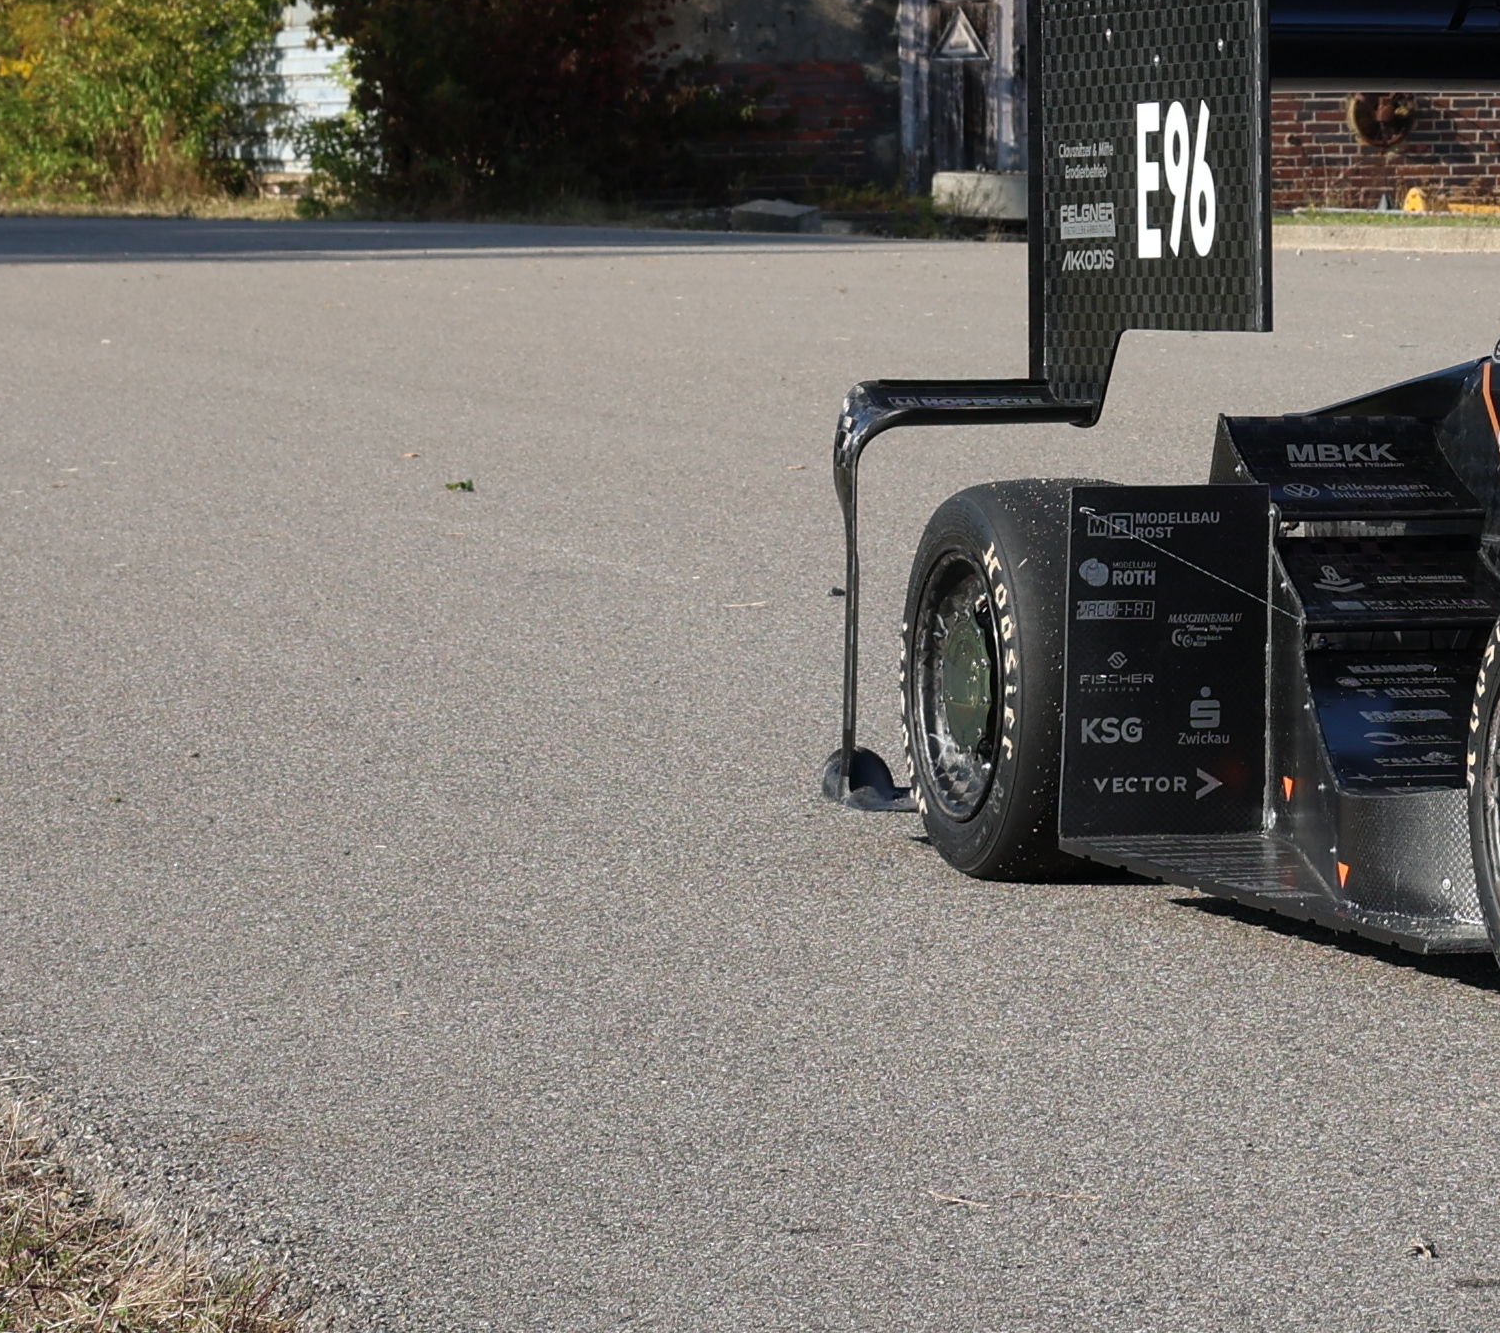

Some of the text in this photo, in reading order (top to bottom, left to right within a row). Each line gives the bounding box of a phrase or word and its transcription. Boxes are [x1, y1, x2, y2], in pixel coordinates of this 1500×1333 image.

[1137, 99, 1216, 259] E96
[1060, 202, 1115, 223] FELGNER
[1286, 443, 1398, 462] MBKK
[1323, 483, 1431, 493] Volkswagen
[1135, 511, 1221, 525] MODELLBAU
[1135, 526, 1174, 539] ROST
[1112, 561, 1157, 569] MODELLBAU
[1112, 569, 1157, 586] ROTH
[1168, 613, 1242, 623] MASCHINENBAU
[1080, 673, 1154, 684] FISCHER
[1081, 716, 1143, 743] KSG
[1177, 731, 1230, 745] Zwickau
[1093, 776, 1188, 794] VECTOR
